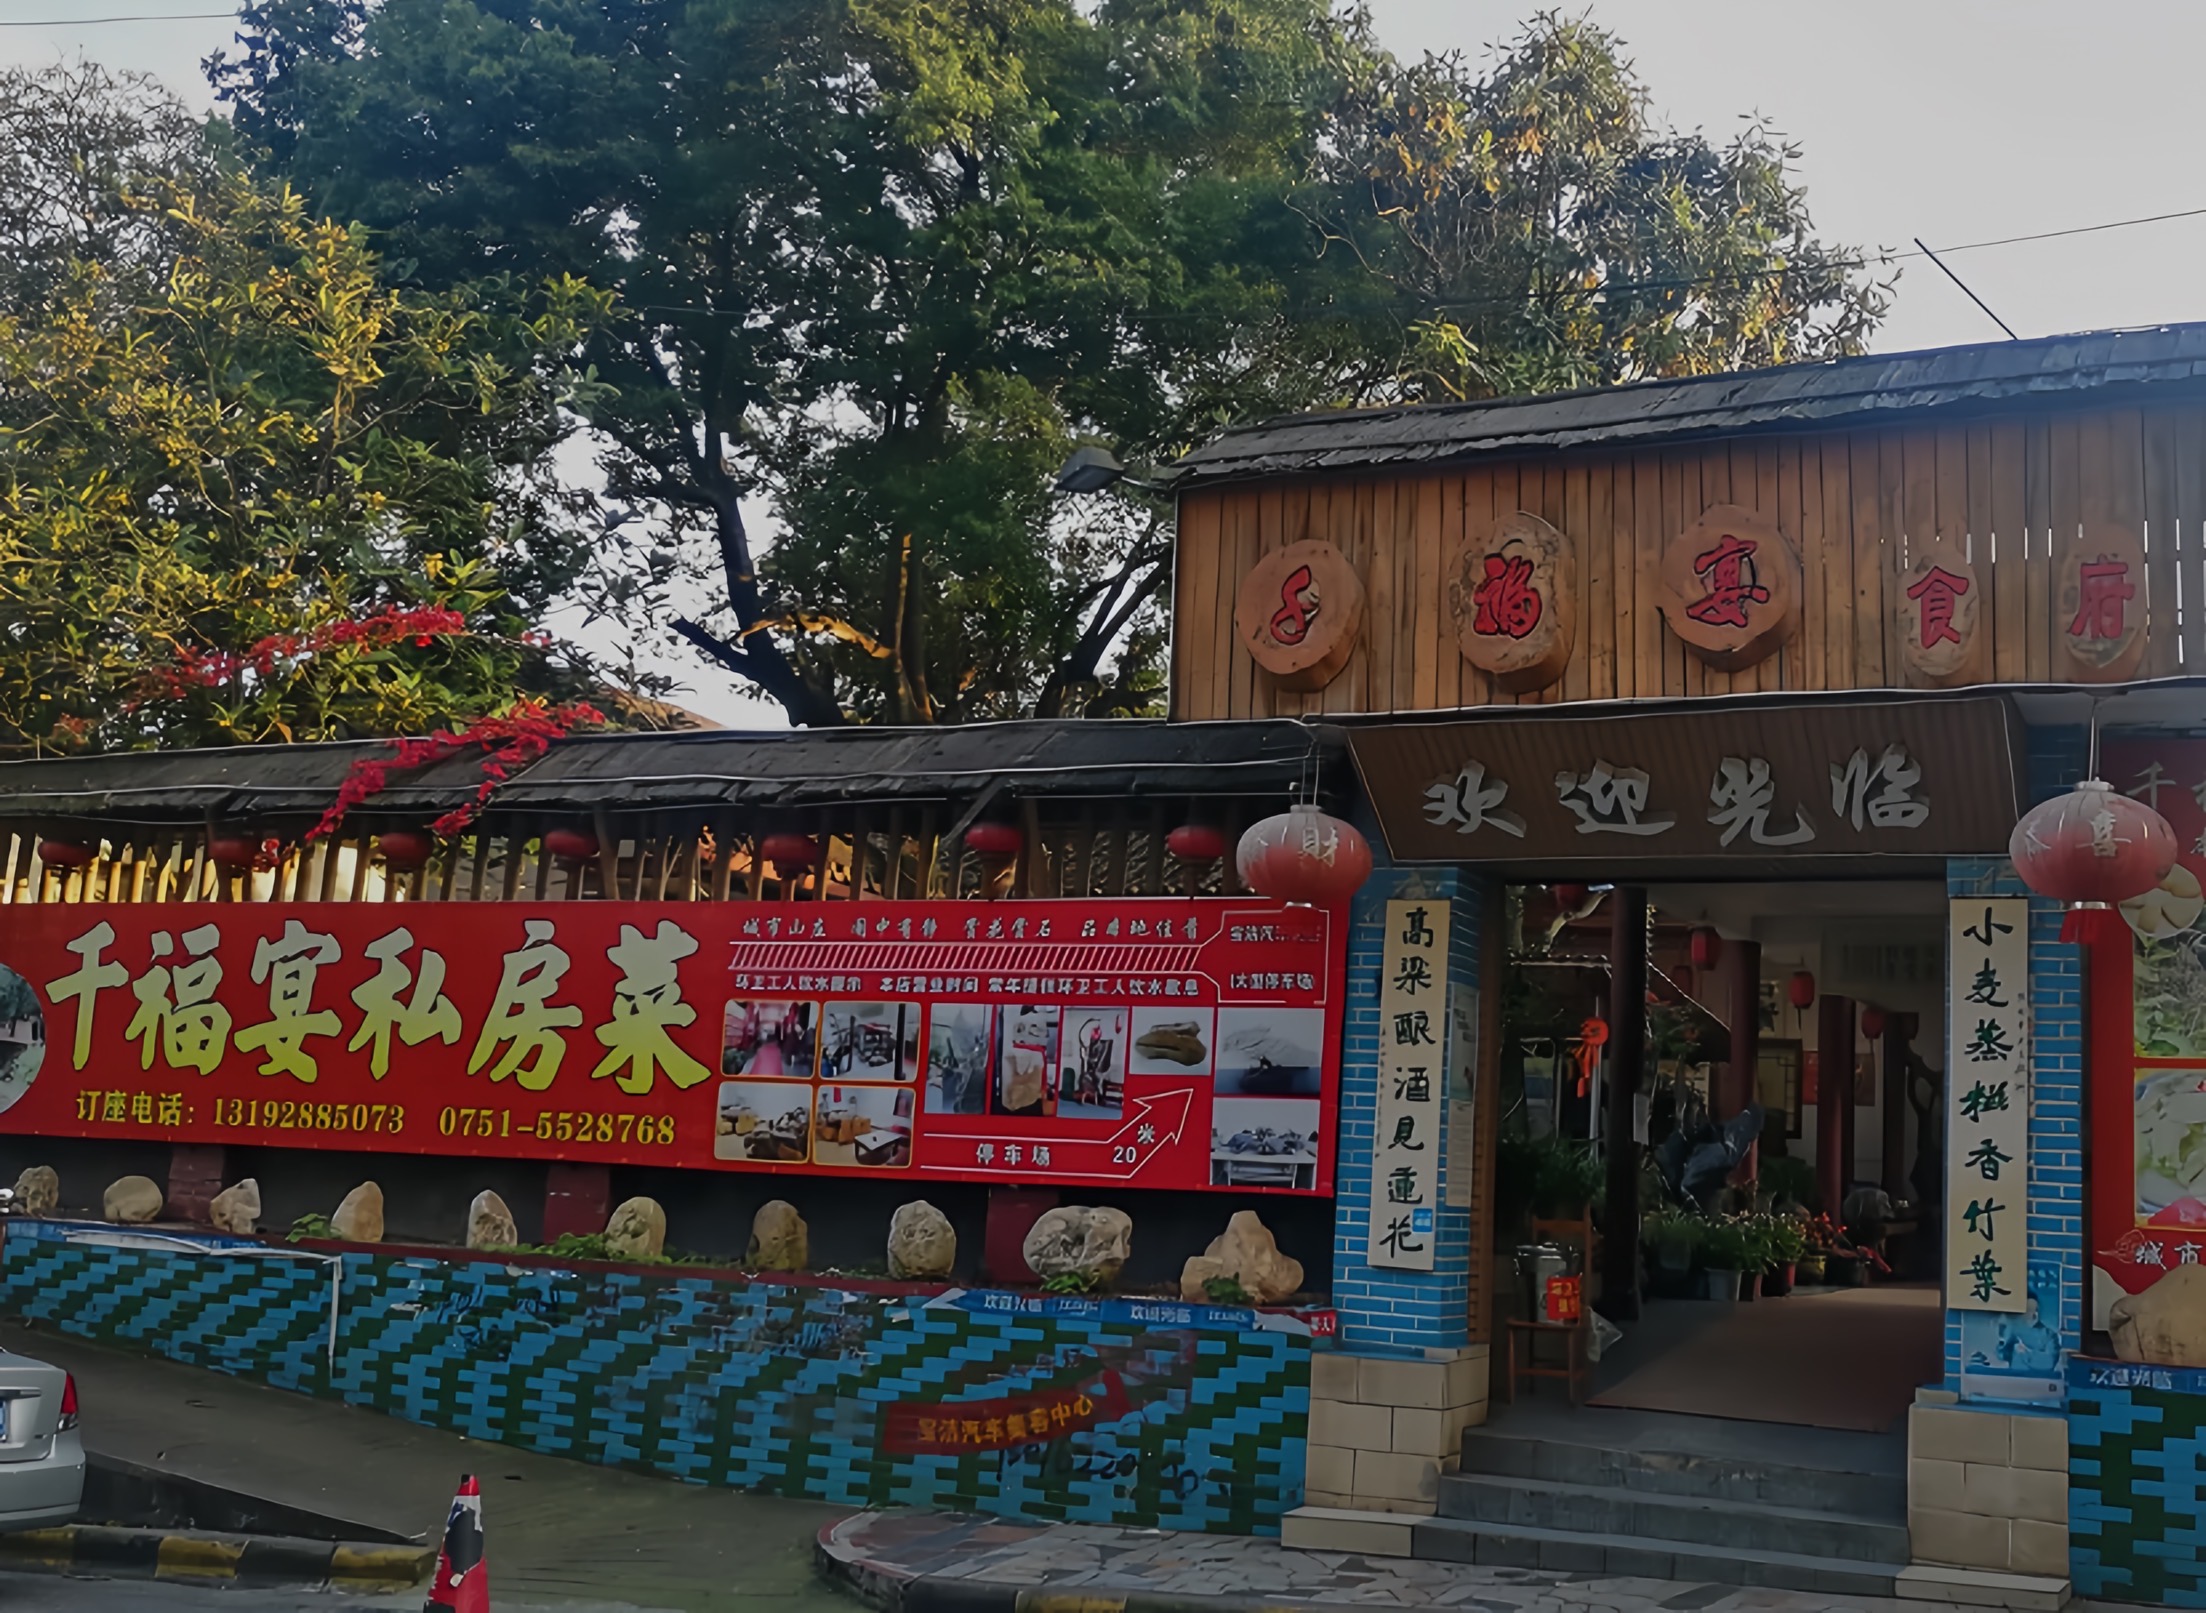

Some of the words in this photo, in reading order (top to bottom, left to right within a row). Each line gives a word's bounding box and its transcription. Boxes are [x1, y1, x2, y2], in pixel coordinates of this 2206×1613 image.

[1423, 743, 1930, 847] 欢迎光临
[45, 919, 711, 1095] 千福宴私房菜
[214, 1098, 405, 1133] 13192885073
[439, 1106, 675, 1145] 0751-5528768
[976, 1143, 1051, 1167] 停车场
